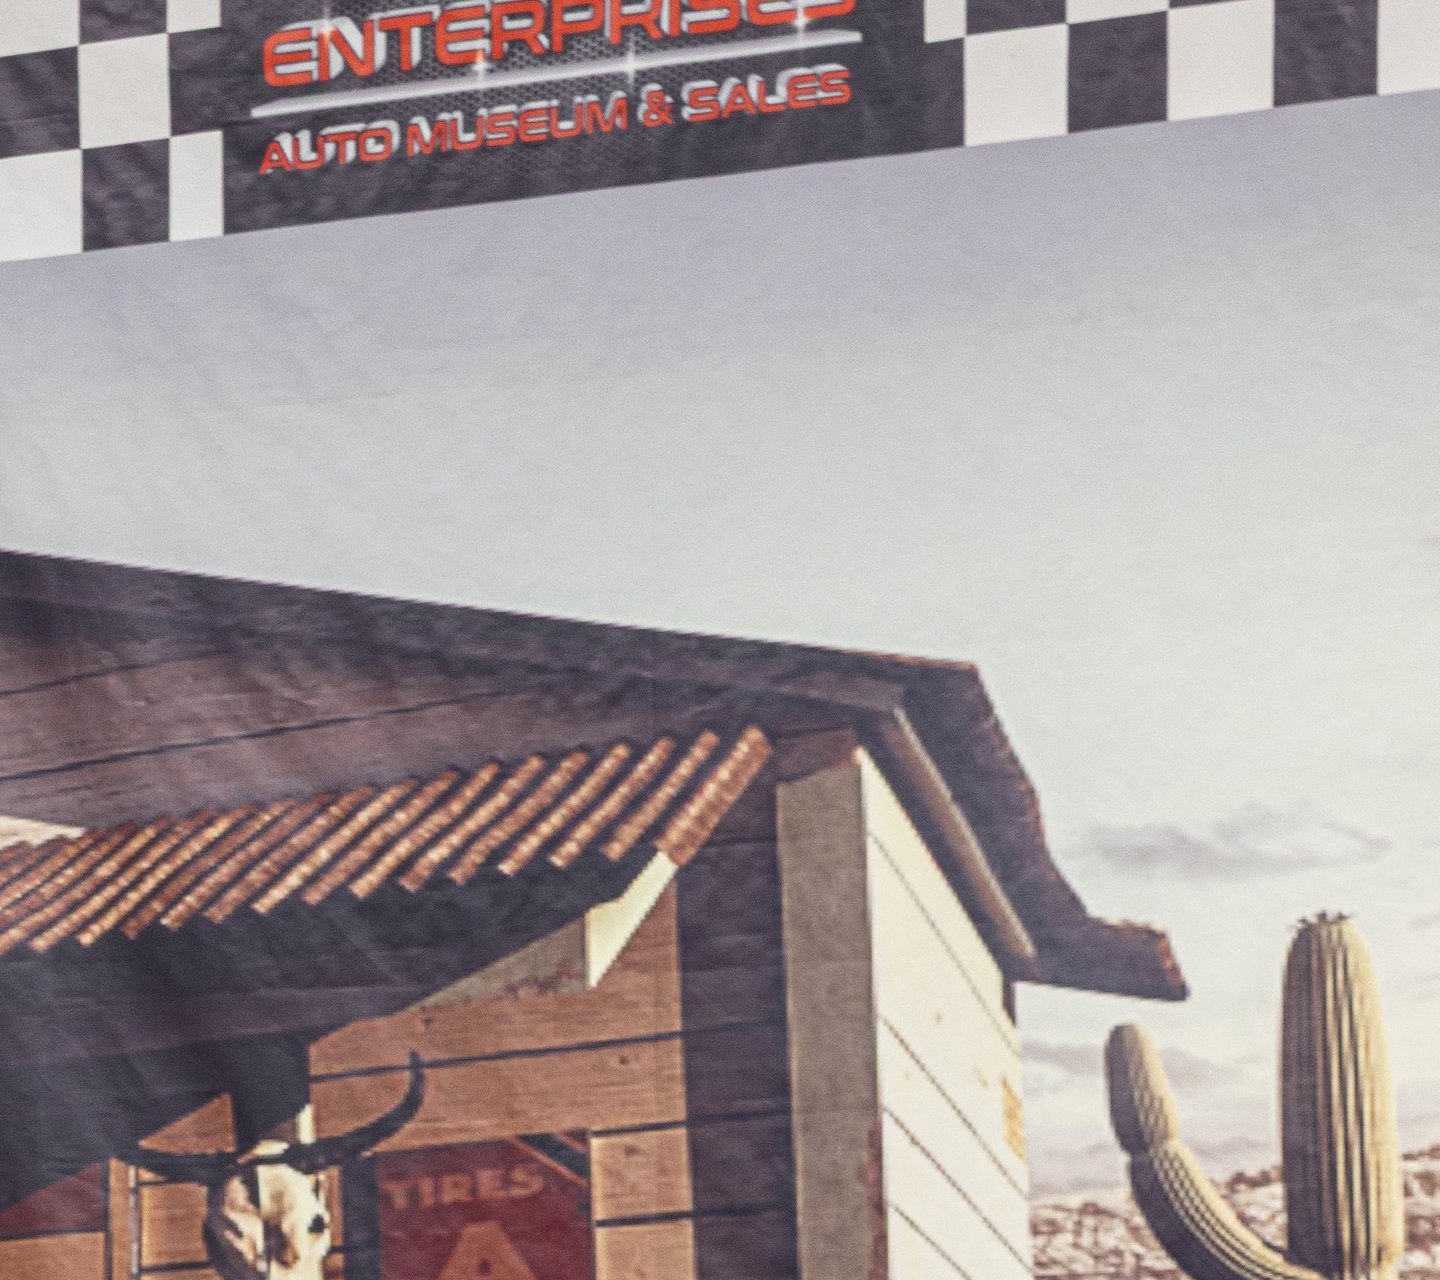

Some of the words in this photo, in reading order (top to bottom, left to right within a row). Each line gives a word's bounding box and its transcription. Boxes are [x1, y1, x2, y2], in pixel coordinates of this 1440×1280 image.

[258, 118, 401, 175] AUTO
[405, 90, 629, 157] MUSEUM
[637, 82, 674, 127] &
[681, 62, 852, 122] SALES
[383, 1164, 545, 1212] TIRES
